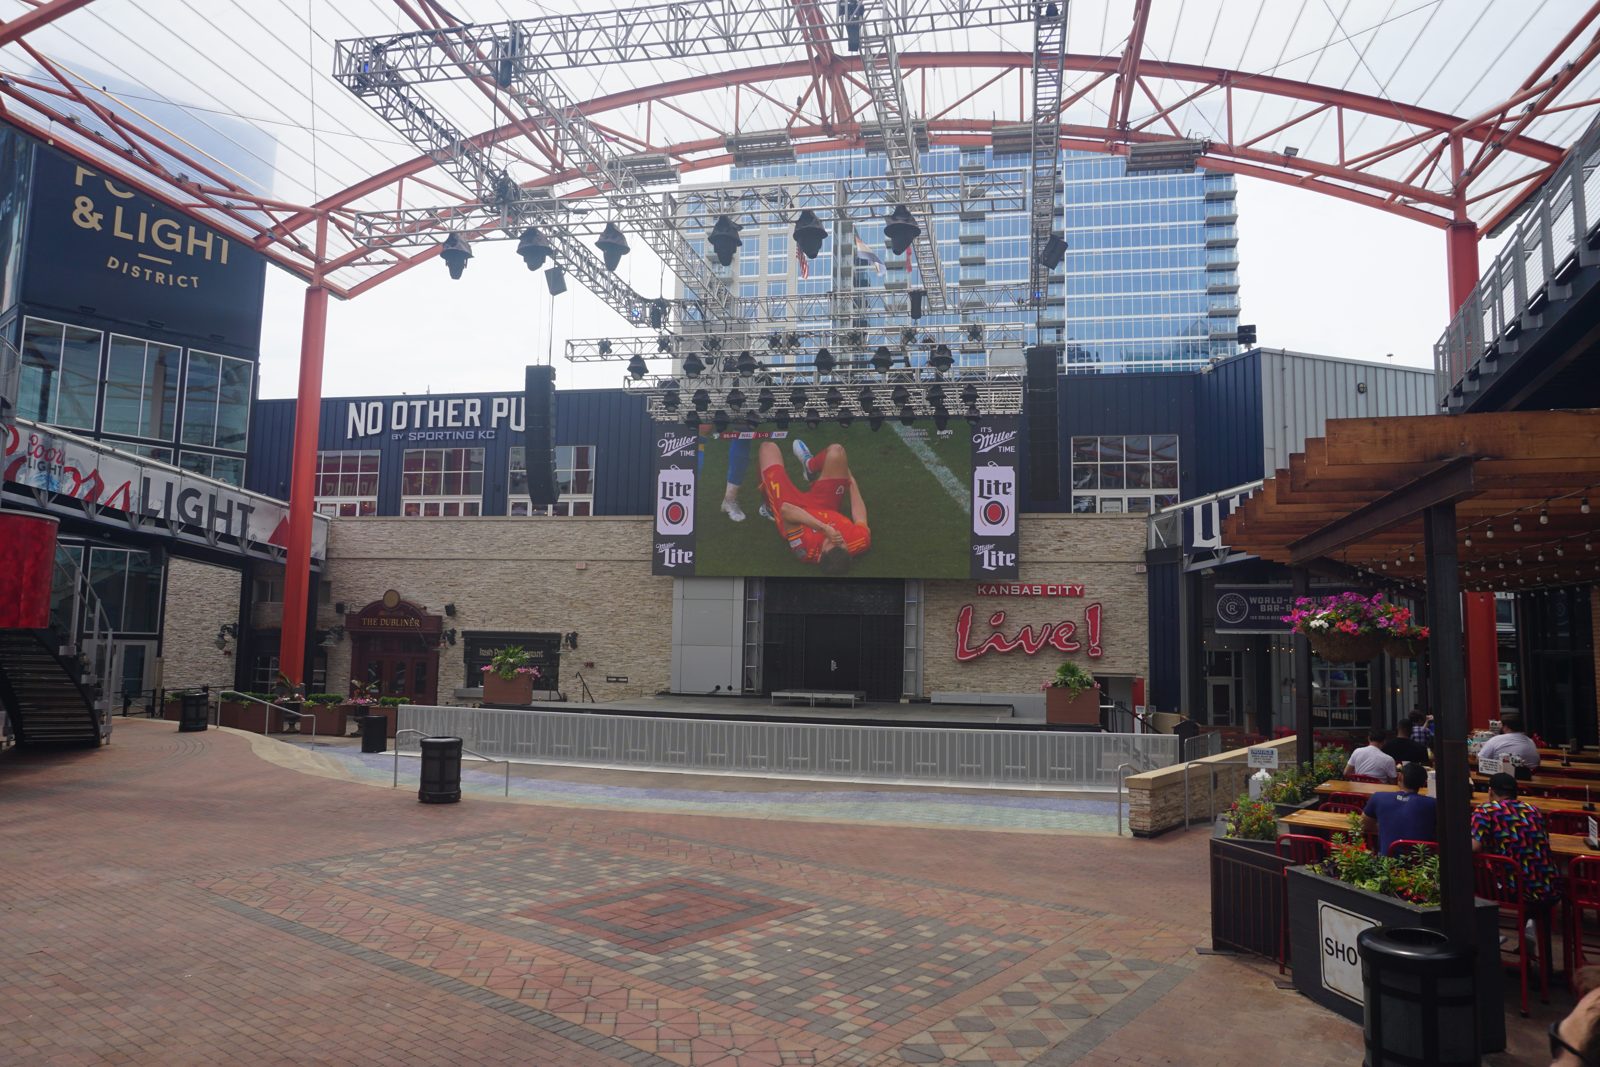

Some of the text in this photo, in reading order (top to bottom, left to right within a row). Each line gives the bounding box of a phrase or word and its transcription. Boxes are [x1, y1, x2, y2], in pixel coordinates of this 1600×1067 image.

[72, 196, 103, 231] &
[107, 256, 199, 288] DISTRICT
[347, 397, 526, 439] NO OTHER PU
[408, 431, 475, 441] SPORTING
[478, 430, 495, 440] KC
[972, 430, 1018, 453] Miller
[657, 436, 697, 457] Miller
[28, 458, 63, 476] LIGHT
[661, 481, 692, 500] Lite
[977, 479, 1012, 499] Lite
[142, 476, 255, 543] LIGHT
[664, 548, 693, 567] Lite
[982, 550, 1016, 570] Lite
[977, 585, 1083, 595] KANSAS CITY
[362, 617, 420, 627] THE DUBLINER
[956, 603, 1102, 662] Live!
[1324, 937, 1358, 967] SHO
